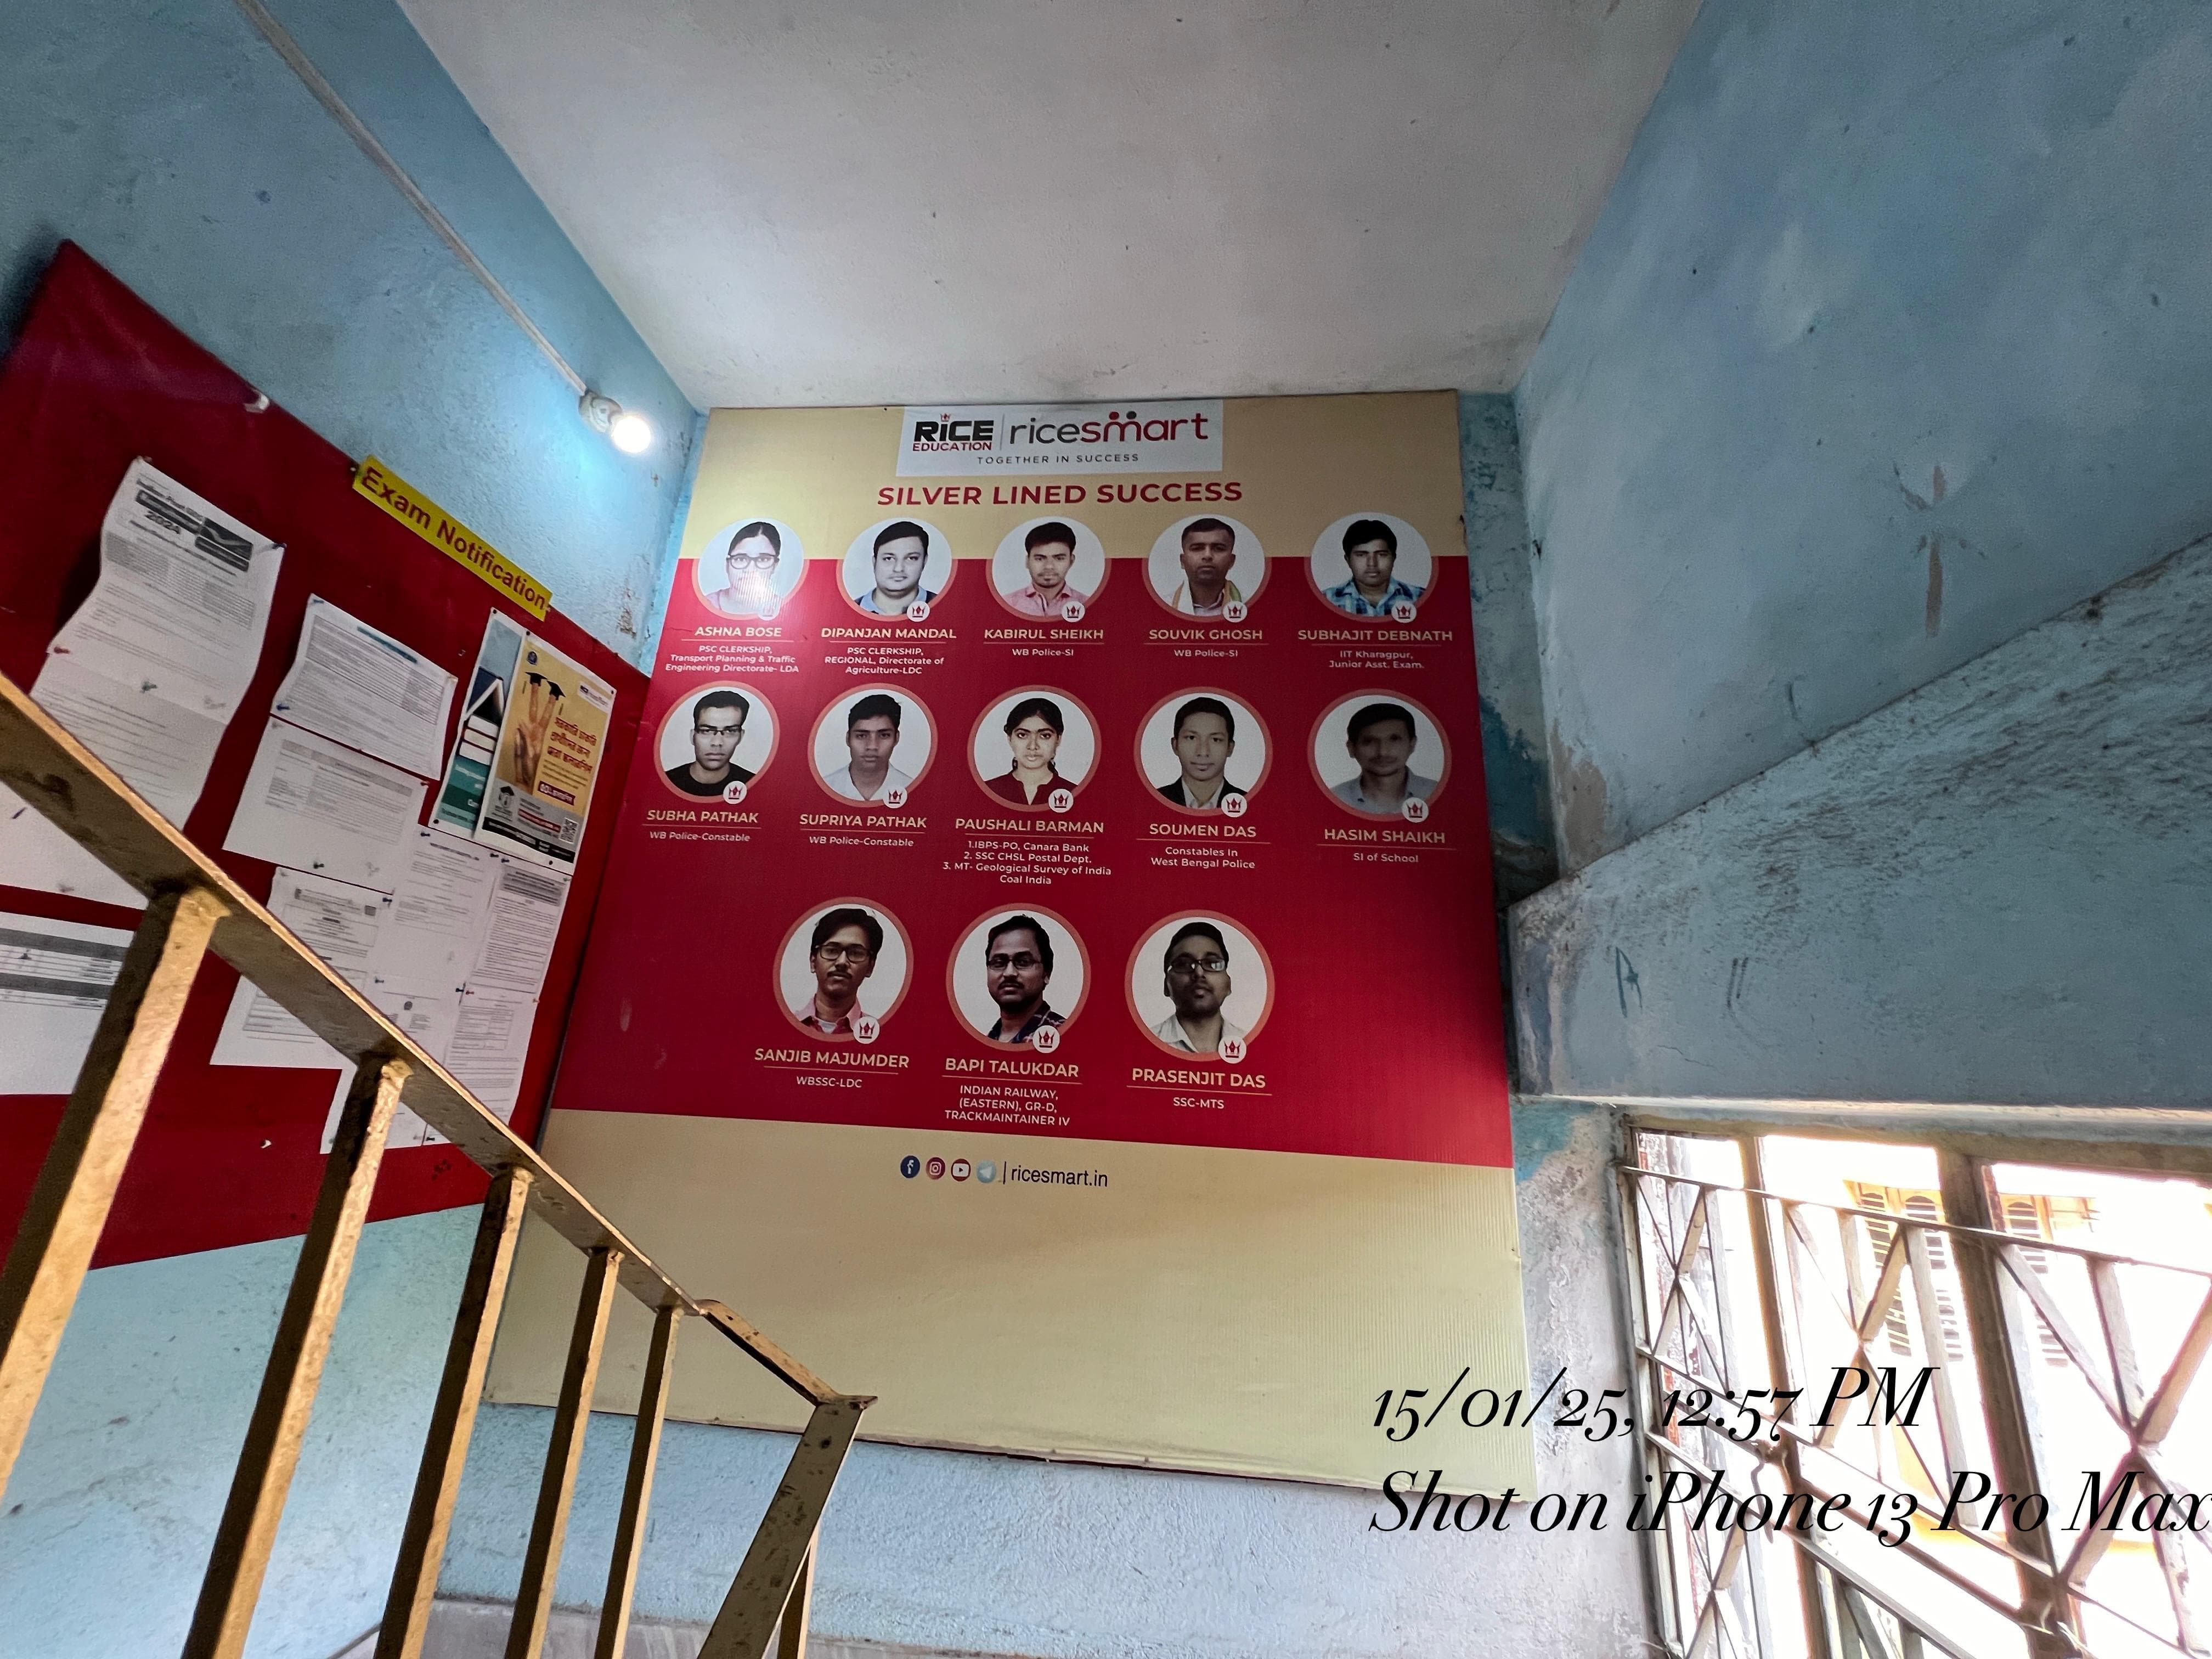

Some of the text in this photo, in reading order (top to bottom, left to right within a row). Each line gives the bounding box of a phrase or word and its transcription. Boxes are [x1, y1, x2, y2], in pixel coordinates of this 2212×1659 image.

[1009, 411, 1208, 444] ricesmart
[912, 441, 991, 452] EDUCATION
[978, 455, 1049, 464] TOGETHER
[1076, 453, 1139, 462] SUCCESS
[878, 482, 1243, 506] SILVER LINED SUCCESS
[360, 466, 546, 610] Exam Notification
[695, 627, 782, 637] ASHNA BOSE
[821, 628, 957, 639] DIPANJAN MANDAL
[984, 629, 1104, 640] KABIRUL SHEIKH
[1149, 630, 1263, 640] SOUVIK GHOSH
[1298, 630, 1453, 641] SUBHAJIT DEBNATH
[868, 647, 924, 656] CLERKSHIP,
[1356, 650, 1413, 660] Kharagpur,
[671, 654, 713, 664] Transport
[715, 655, 757, 664] Planning
[825, 656, 876, 665] REGIONAL,
[934, 657, 945, 665] of
[1329, 660, 1425, 669] Junior Asst. Exam.
[665, 664, 720, 674] Engineering
[723, 664, 777, 673] Directorate-
[845, 666, 922, 675] Agriculture-LDC
[647, 810, 759, 823] SUBHA PATHAK
[799, 814, 927, 828] SUPRIYA PATHAK
[956, 819, 1104, 833] PAUSHALI BARMAN
[1149, 823, 1257, 837] SOUMEN DAS
[669, 832, 751, 842] Police-Constable
[830, 837, 915, 847] Police-Constable
[1324, 828, 1446, 844] HASIM SHAIKH
[968, 840, 1090, 852] 1.IBPS-PO, Canara Bank
[1165, 847, 1238, 857] Constables In
[975, 852, 995, 860] SSC
[998, 853, 1025, 861] CHSL
[1028, 854, 1060, 862] Postal
[1064, 855, 1092, 864] Dept.
[1151, 857, 1256, 870] West Bengal Police
[1353, 853, 1419, 863] SI of School
[976, 863, 1030, 873] Geological
[1033, 865, 1069, 876] Survey
[1071, 866, 1082, 874] of
[1085, 866, 1111, 875] India
[1000, 875, 1052, 884] Coal India
[754, 1048, 910, 1068] SANJIB MAJUMDER
[945, 1058, 1079, 1077] BAPI TALUKDAR
[796, 1076, 862, 1088] WBSSC-LDC
[1132, 1068, 1266, 1089] PRASENJIT DAS
[960, 1085, 1059, 1101] INDIAN RAILWAY,
[958, 1097, 1058, 1114] (EASTERN), GR-D,
[1173, 1097, 1224, 1110] SSC-MTS
[945, 1110, 1070, 1126] TRACKMAINTAINER IV
[1011, 1165, 1108, 1188] ricesmart.in
